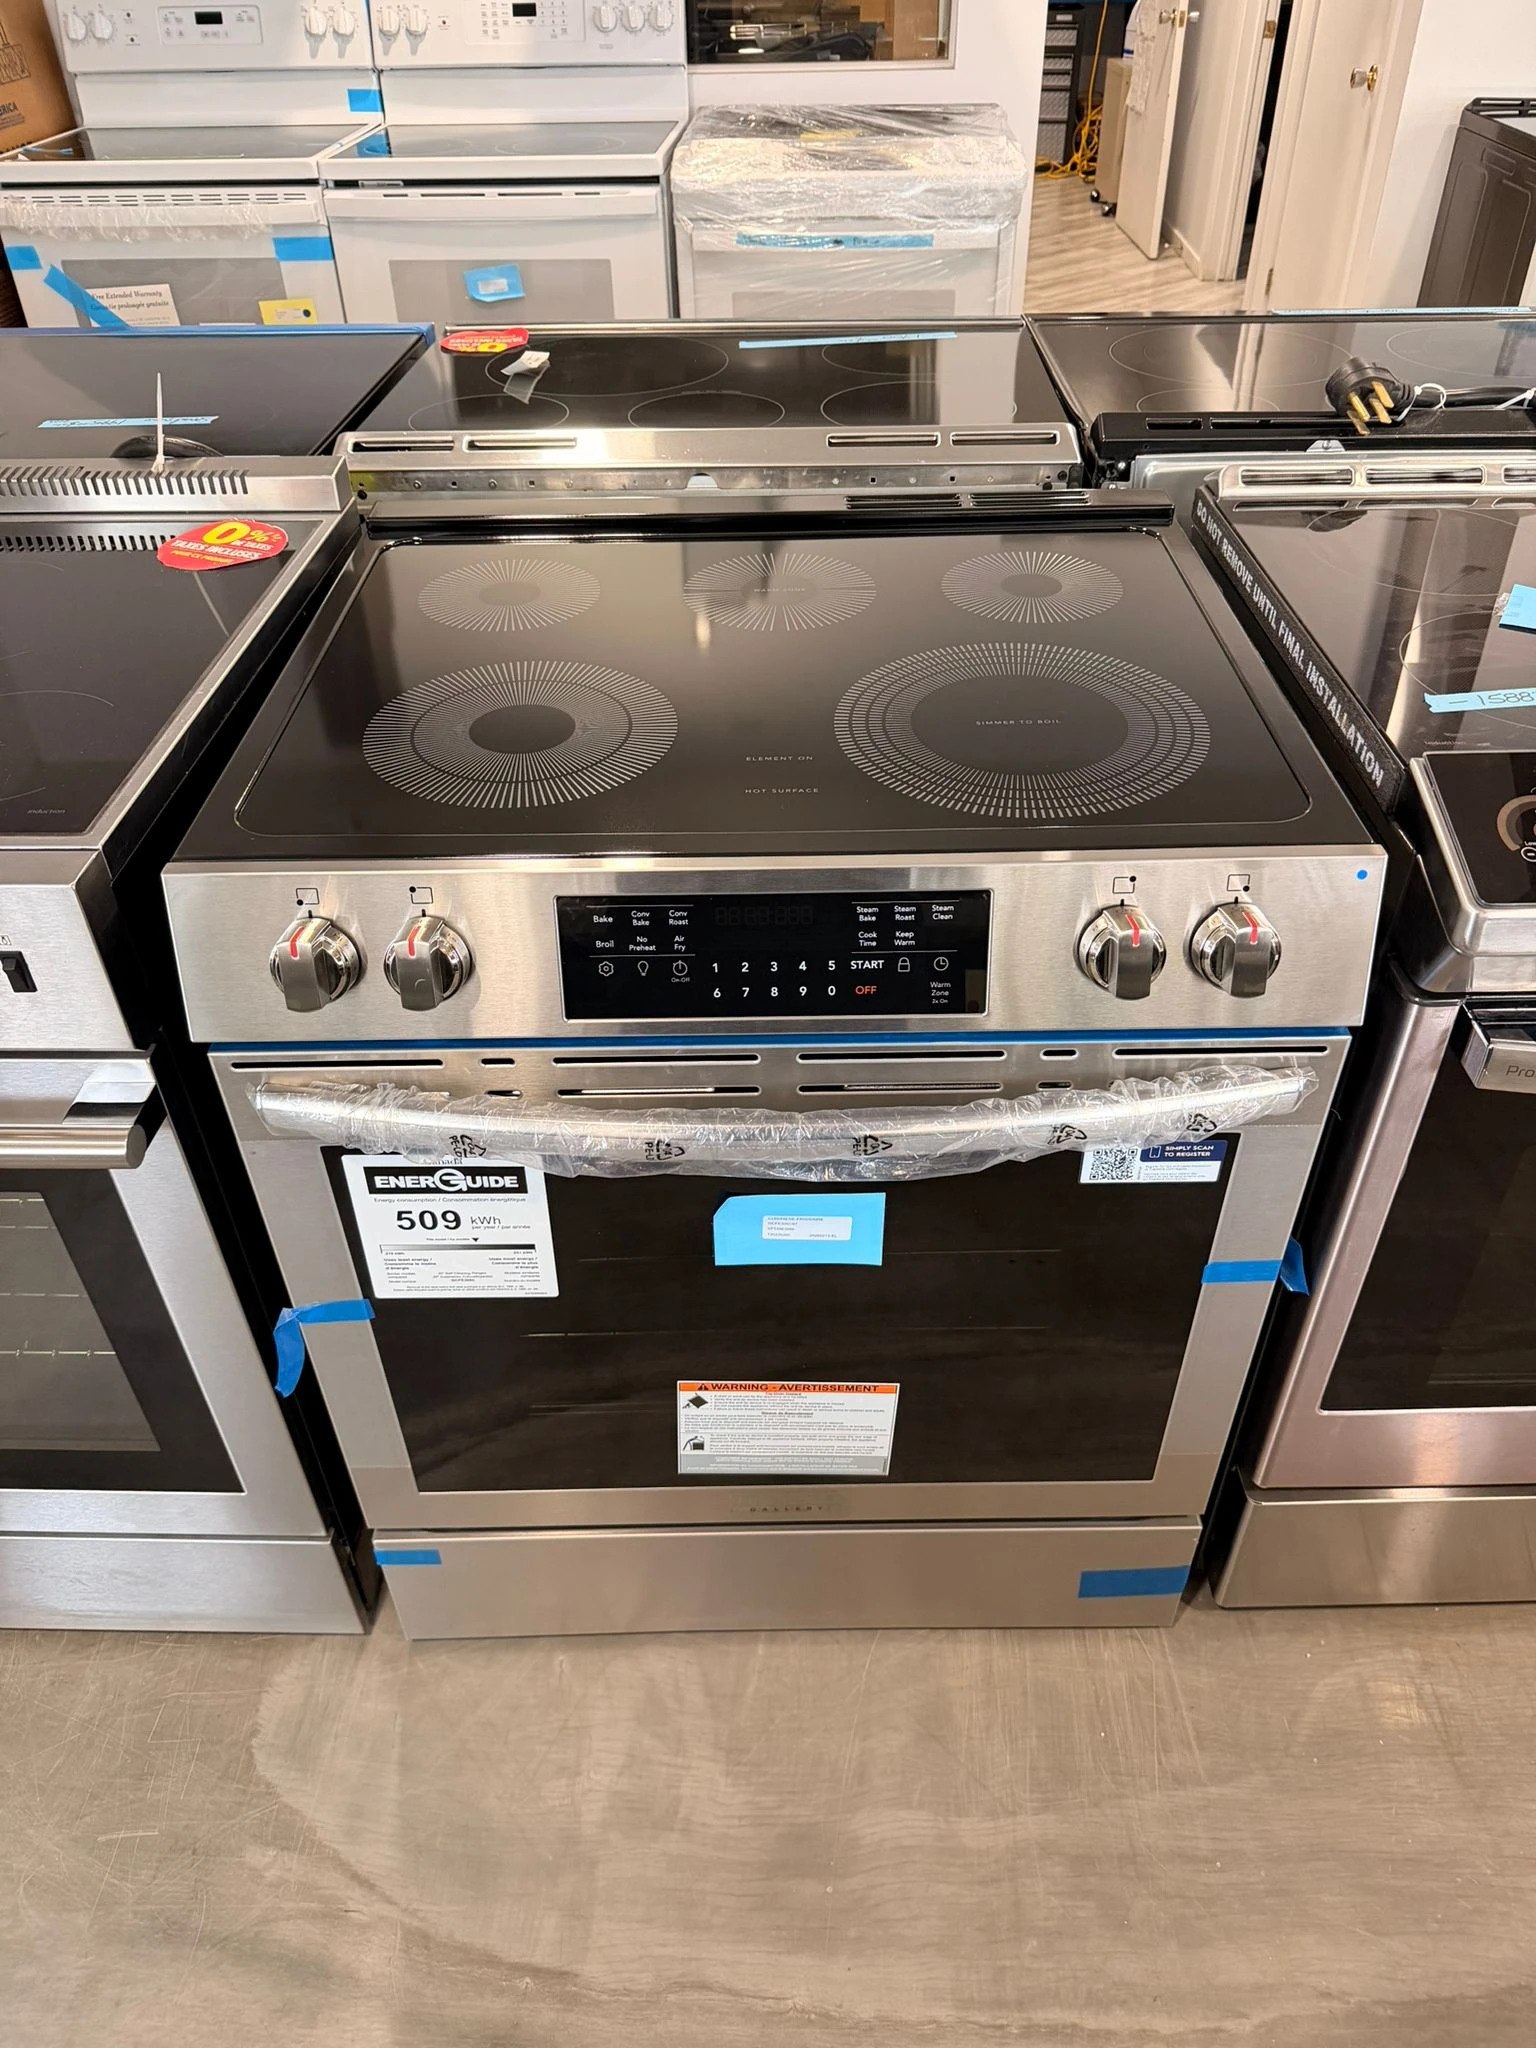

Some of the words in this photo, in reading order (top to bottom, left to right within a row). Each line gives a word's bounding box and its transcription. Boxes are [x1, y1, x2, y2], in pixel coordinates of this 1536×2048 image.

[171, 539, 209, 551] TAXES
[205, 545, 263, 559] INCLUSES
[1197, 499, 1209, 524] DO
[1206, 515, 1222, 547] NOT
[1220, 538, 1253, 593] REMOVE
[1252, 579, 1278, 631] UNTIL
[1278, 618, 1306, 670] FINAL
[1305, 659, 1384, 789] INSTALLATION
[1478, 690, 1536, 707] 1588
[856, 906, 879, 914] Steam
[894, 905, 917, 913] Steam
[931, 904, 954, 913] Steam
[631, 910, 650, 918] Conv
[669, 909, 687, 918] Conv
[859, 914, 877, 922] Bake
[895, 913, 915, 921] Roast
[932, 912, 953, 921] Clean
[593, 914, 613, 924] Bake
[632, 918, 650, 926] Bake
[668, 918, 689, 926] Roast
[637, 935, 648, 944] No
[674, 935, 685, 943] Air
[858, 931, 878, 939] Cook
[895, 930, 915, 940] Keep
[595, 940, 614, 949] Broil
[858, 939, 877, 947] Time
[894, 938, 916, 946] Warm
[629, 943, 656, 952] Preheat
[674, 943, 686, 952] Fry
[713, 963, 719, 973] 1
[741, 962, 749, 972] 2
[771, 962, 778, 972] 3
[799, 961, 807, 972] 4
[828, 961, 835, 971] 5
[850, 960, 884, 970] START
[930, 981, 951, 989] Warm
[713, 988, 721, 998] 6
[742, 988, 750, 998] 7
[771, 987, 778, 997] 8
[799, 987, 807, 997] 9
[828, 986, 836, 996] 0
[855, 986, 877, 996] OFF
[931, 989, 950, 997] Zone
[373, 1168, 519, 1192] ENERGUIDE
[396, 1209, 462, 1231] 509
[470, 1216, 502, 1225] kWh
[711, 1383, 769, 1392] WARNING
[778, 1384, 879, 1393] AVERTISSEMENT
